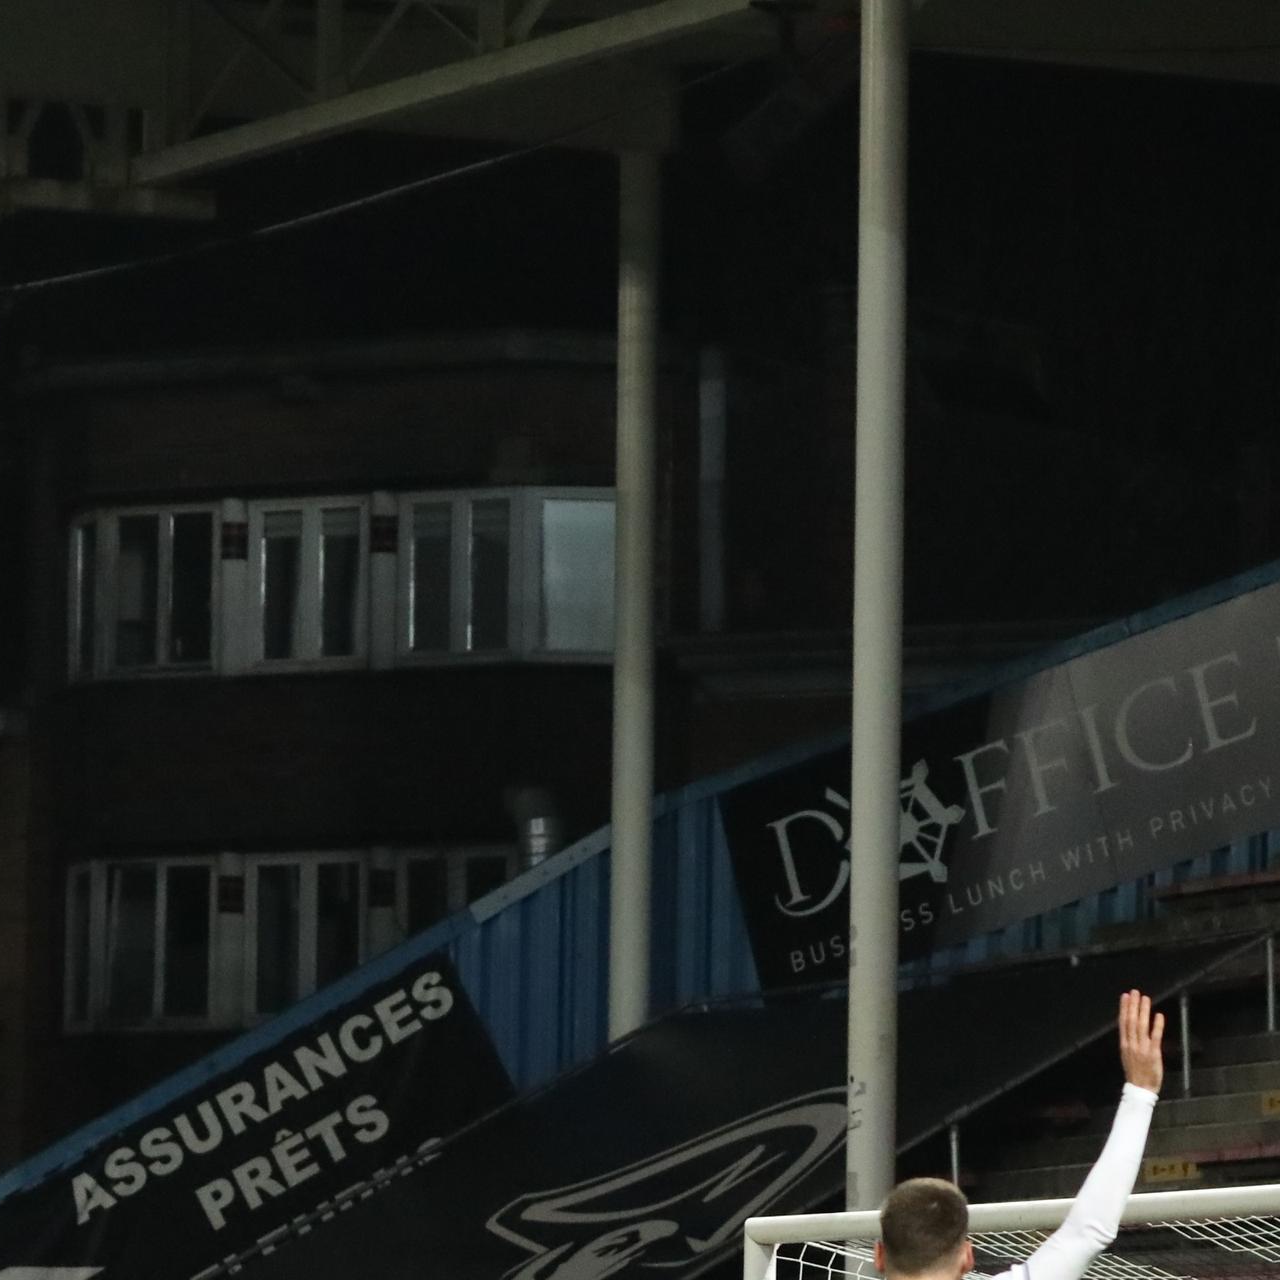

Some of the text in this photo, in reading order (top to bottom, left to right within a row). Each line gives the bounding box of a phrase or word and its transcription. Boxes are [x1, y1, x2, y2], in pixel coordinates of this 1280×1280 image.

[948, 861, 1048, 916] LUNCH
[1059, 829, 1134, 874] WITH
[1148, 776, 1275, 841] PRIVACY
[71, 970, 455, 1226] ASSURANCES
[195, 1093, 391, 1231] PRÊTS
